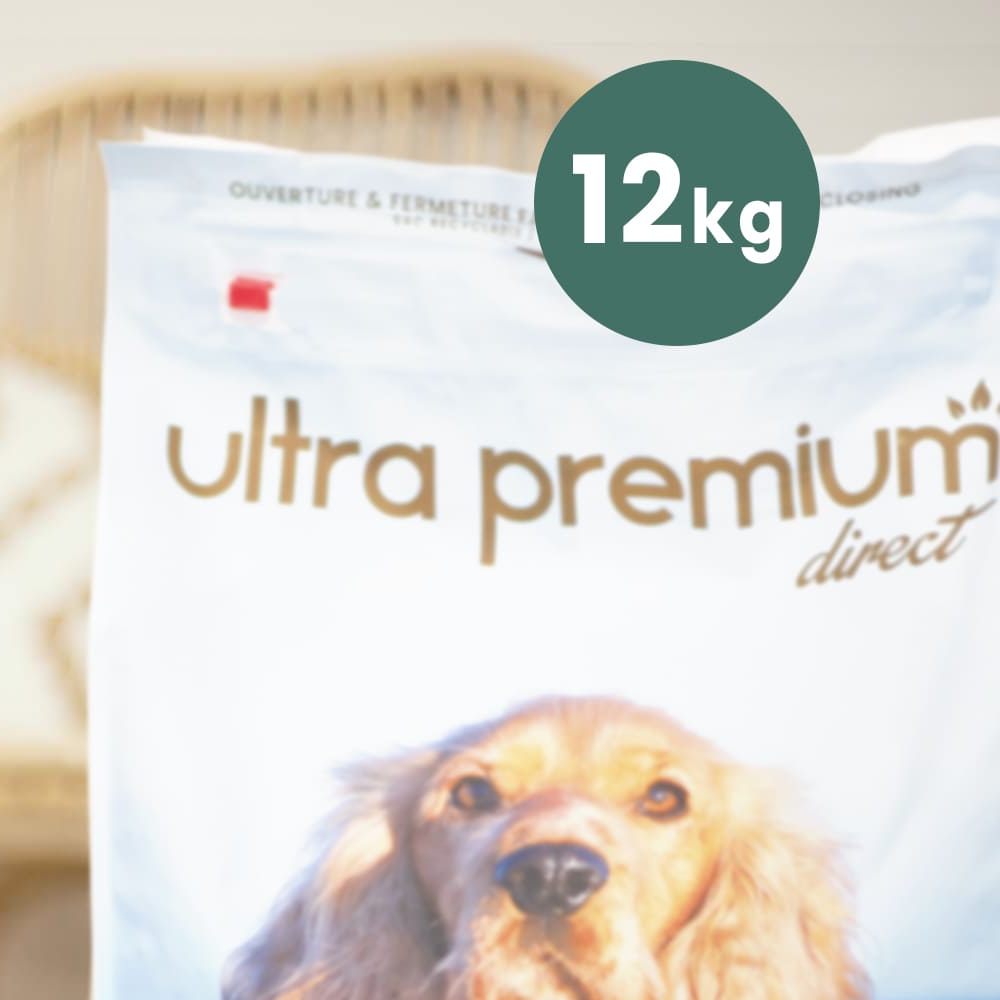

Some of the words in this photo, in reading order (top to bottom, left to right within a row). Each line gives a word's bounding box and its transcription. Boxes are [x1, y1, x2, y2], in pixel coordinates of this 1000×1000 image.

[229, 181, 357, 209] OUVERTURE
[366, 191, 382, 209] &
[390, 192, 510, 221] FERMETURE
[167, 396, 436, 521] ultra
[480, 422, 1000, 567] premium
[795, 499, 999, 589] direct
